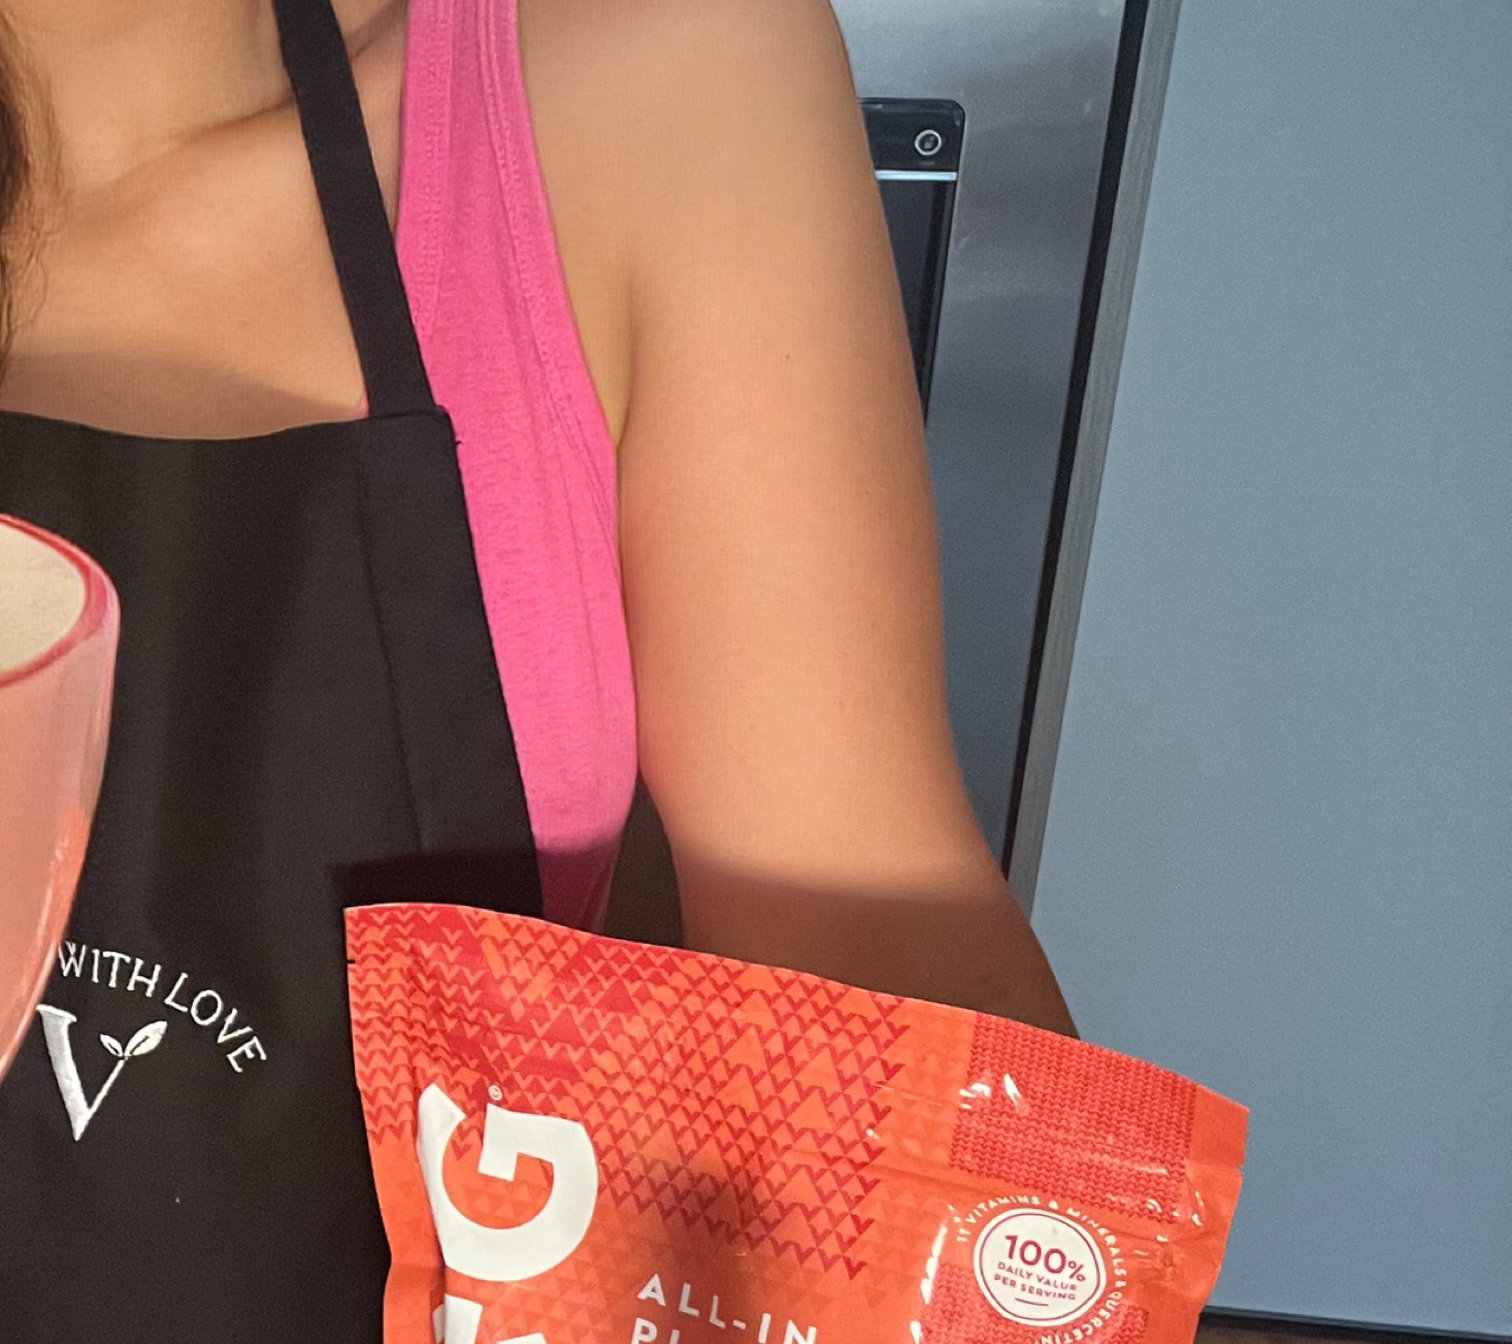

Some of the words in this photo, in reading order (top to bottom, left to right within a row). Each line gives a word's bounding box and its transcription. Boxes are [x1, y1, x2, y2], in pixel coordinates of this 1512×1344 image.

[57, 940, 162, 998] WITH
[164, 971, 267, 1074] LOVE
[964, 1195, 1041, 1225] VITAMINS
[1066, 1207, 1128, 1276] MINERALS
[1004, 1234, 1086, 1283] 100%
[994, 1273, 1017, 1288] PER
[1020, 1283, 1076, 1301] SERVING
[997, 1261, 1033, 1282] DAILY
[1036, 1274, 1078, 1292] VALUE
